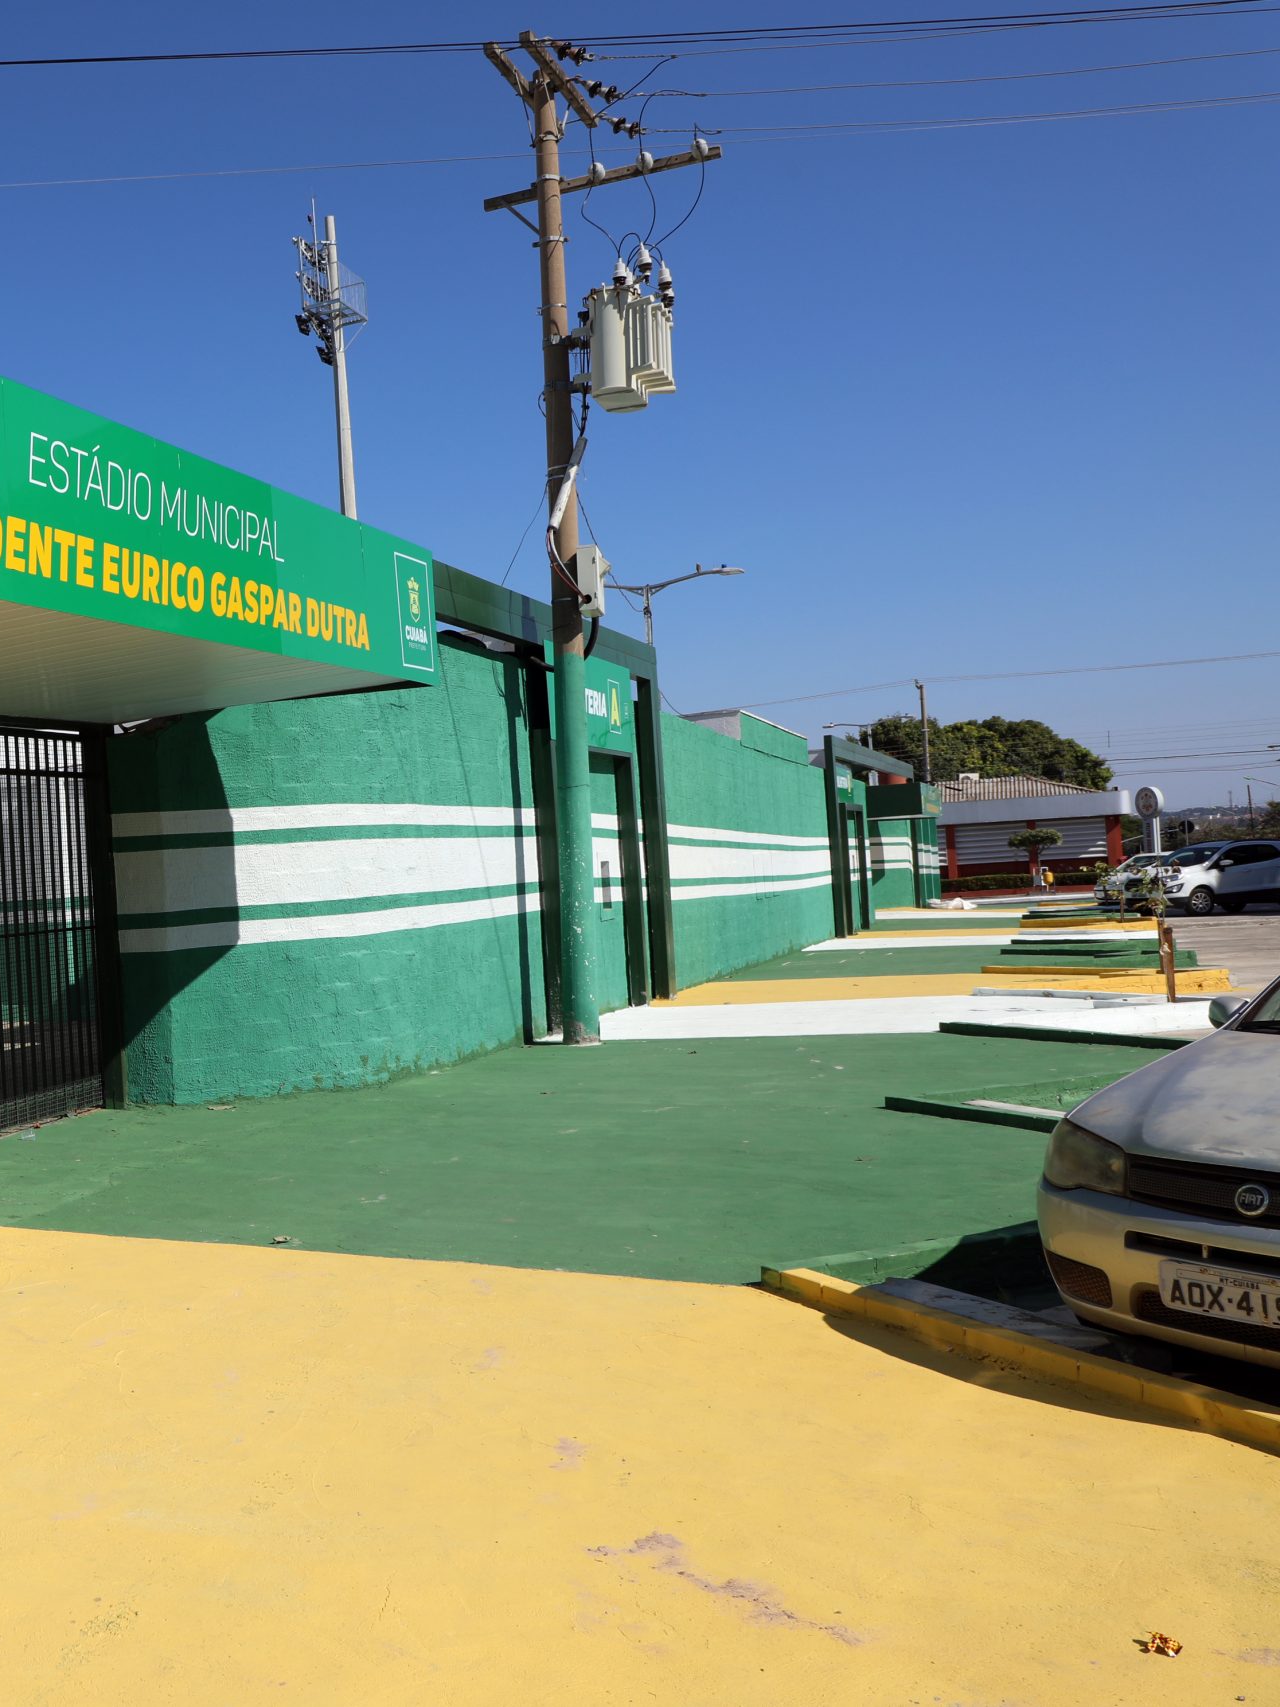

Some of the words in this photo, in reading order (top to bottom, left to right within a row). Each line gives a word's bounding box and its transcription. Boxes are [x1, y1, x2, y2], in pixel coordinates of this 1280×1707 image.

[28, 431, 152, 521] ESTÁDIO
[159, 480, 286, 563] MUNICIPAL
[102, 541, 205, 614] EURICO
[210, 571, 303, 635] GASPAR
[306, 597, 371, 651] DUTRA
[405, 625, 429, 645] CUIABÁ
[610, 687, 621, 727] A
[1239, 1192, 1264, 1206] FIAT
